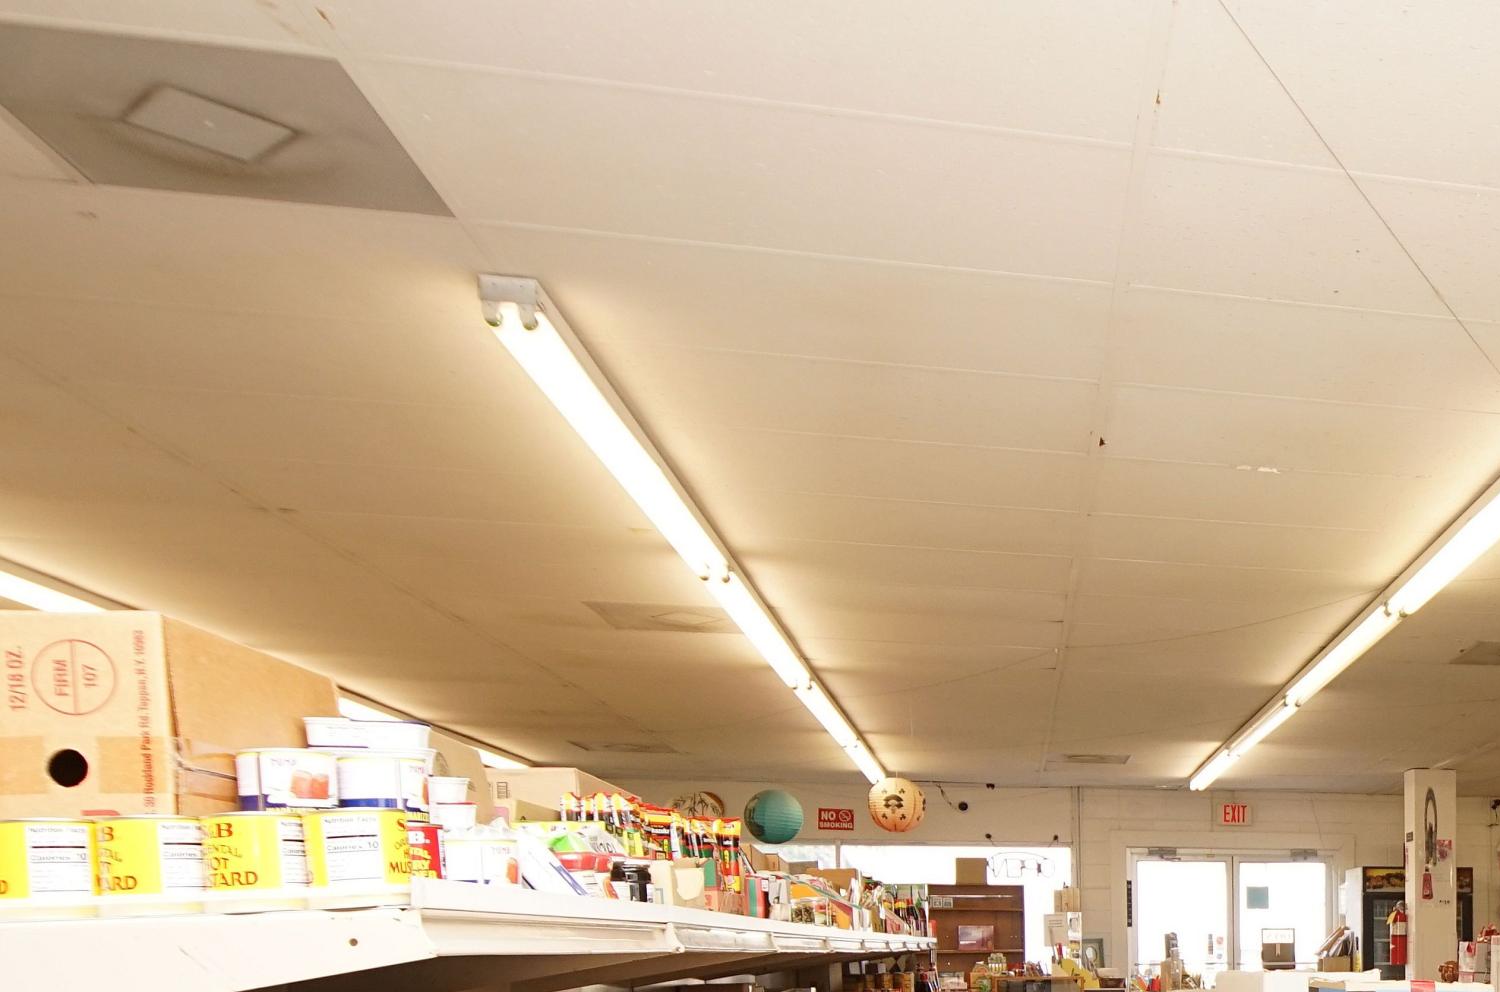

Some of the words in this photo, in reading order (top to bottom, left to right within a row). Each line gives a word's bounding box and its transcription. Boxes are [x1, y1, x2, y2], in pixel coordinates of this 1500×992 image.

[53, 659, 69, 697] FIRM
[82, 664, 98, 688] 107
[820, 810, 836, 821] NO
[1223, 805, 1247, 823] EXIT
